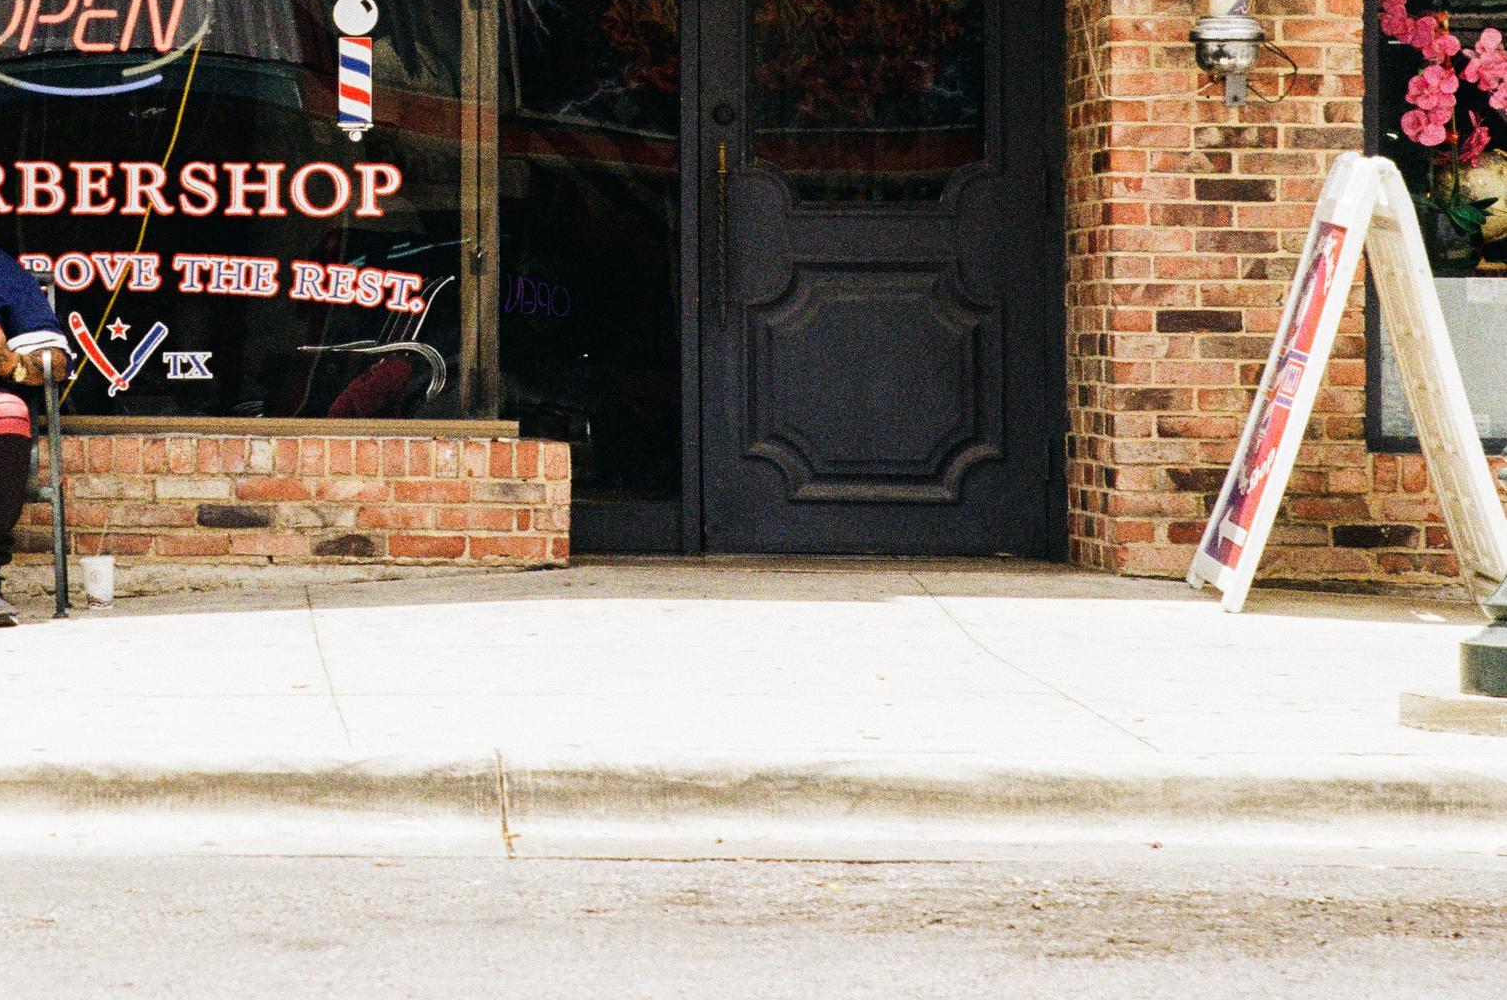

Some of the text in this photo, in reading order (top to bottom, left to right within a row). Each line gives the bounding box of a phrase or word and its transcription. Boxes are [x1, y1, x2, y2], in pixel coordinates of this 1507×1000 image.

[18, 250, 427, 314] OVE THE REST.
[162, 351, 213, 380] TX
